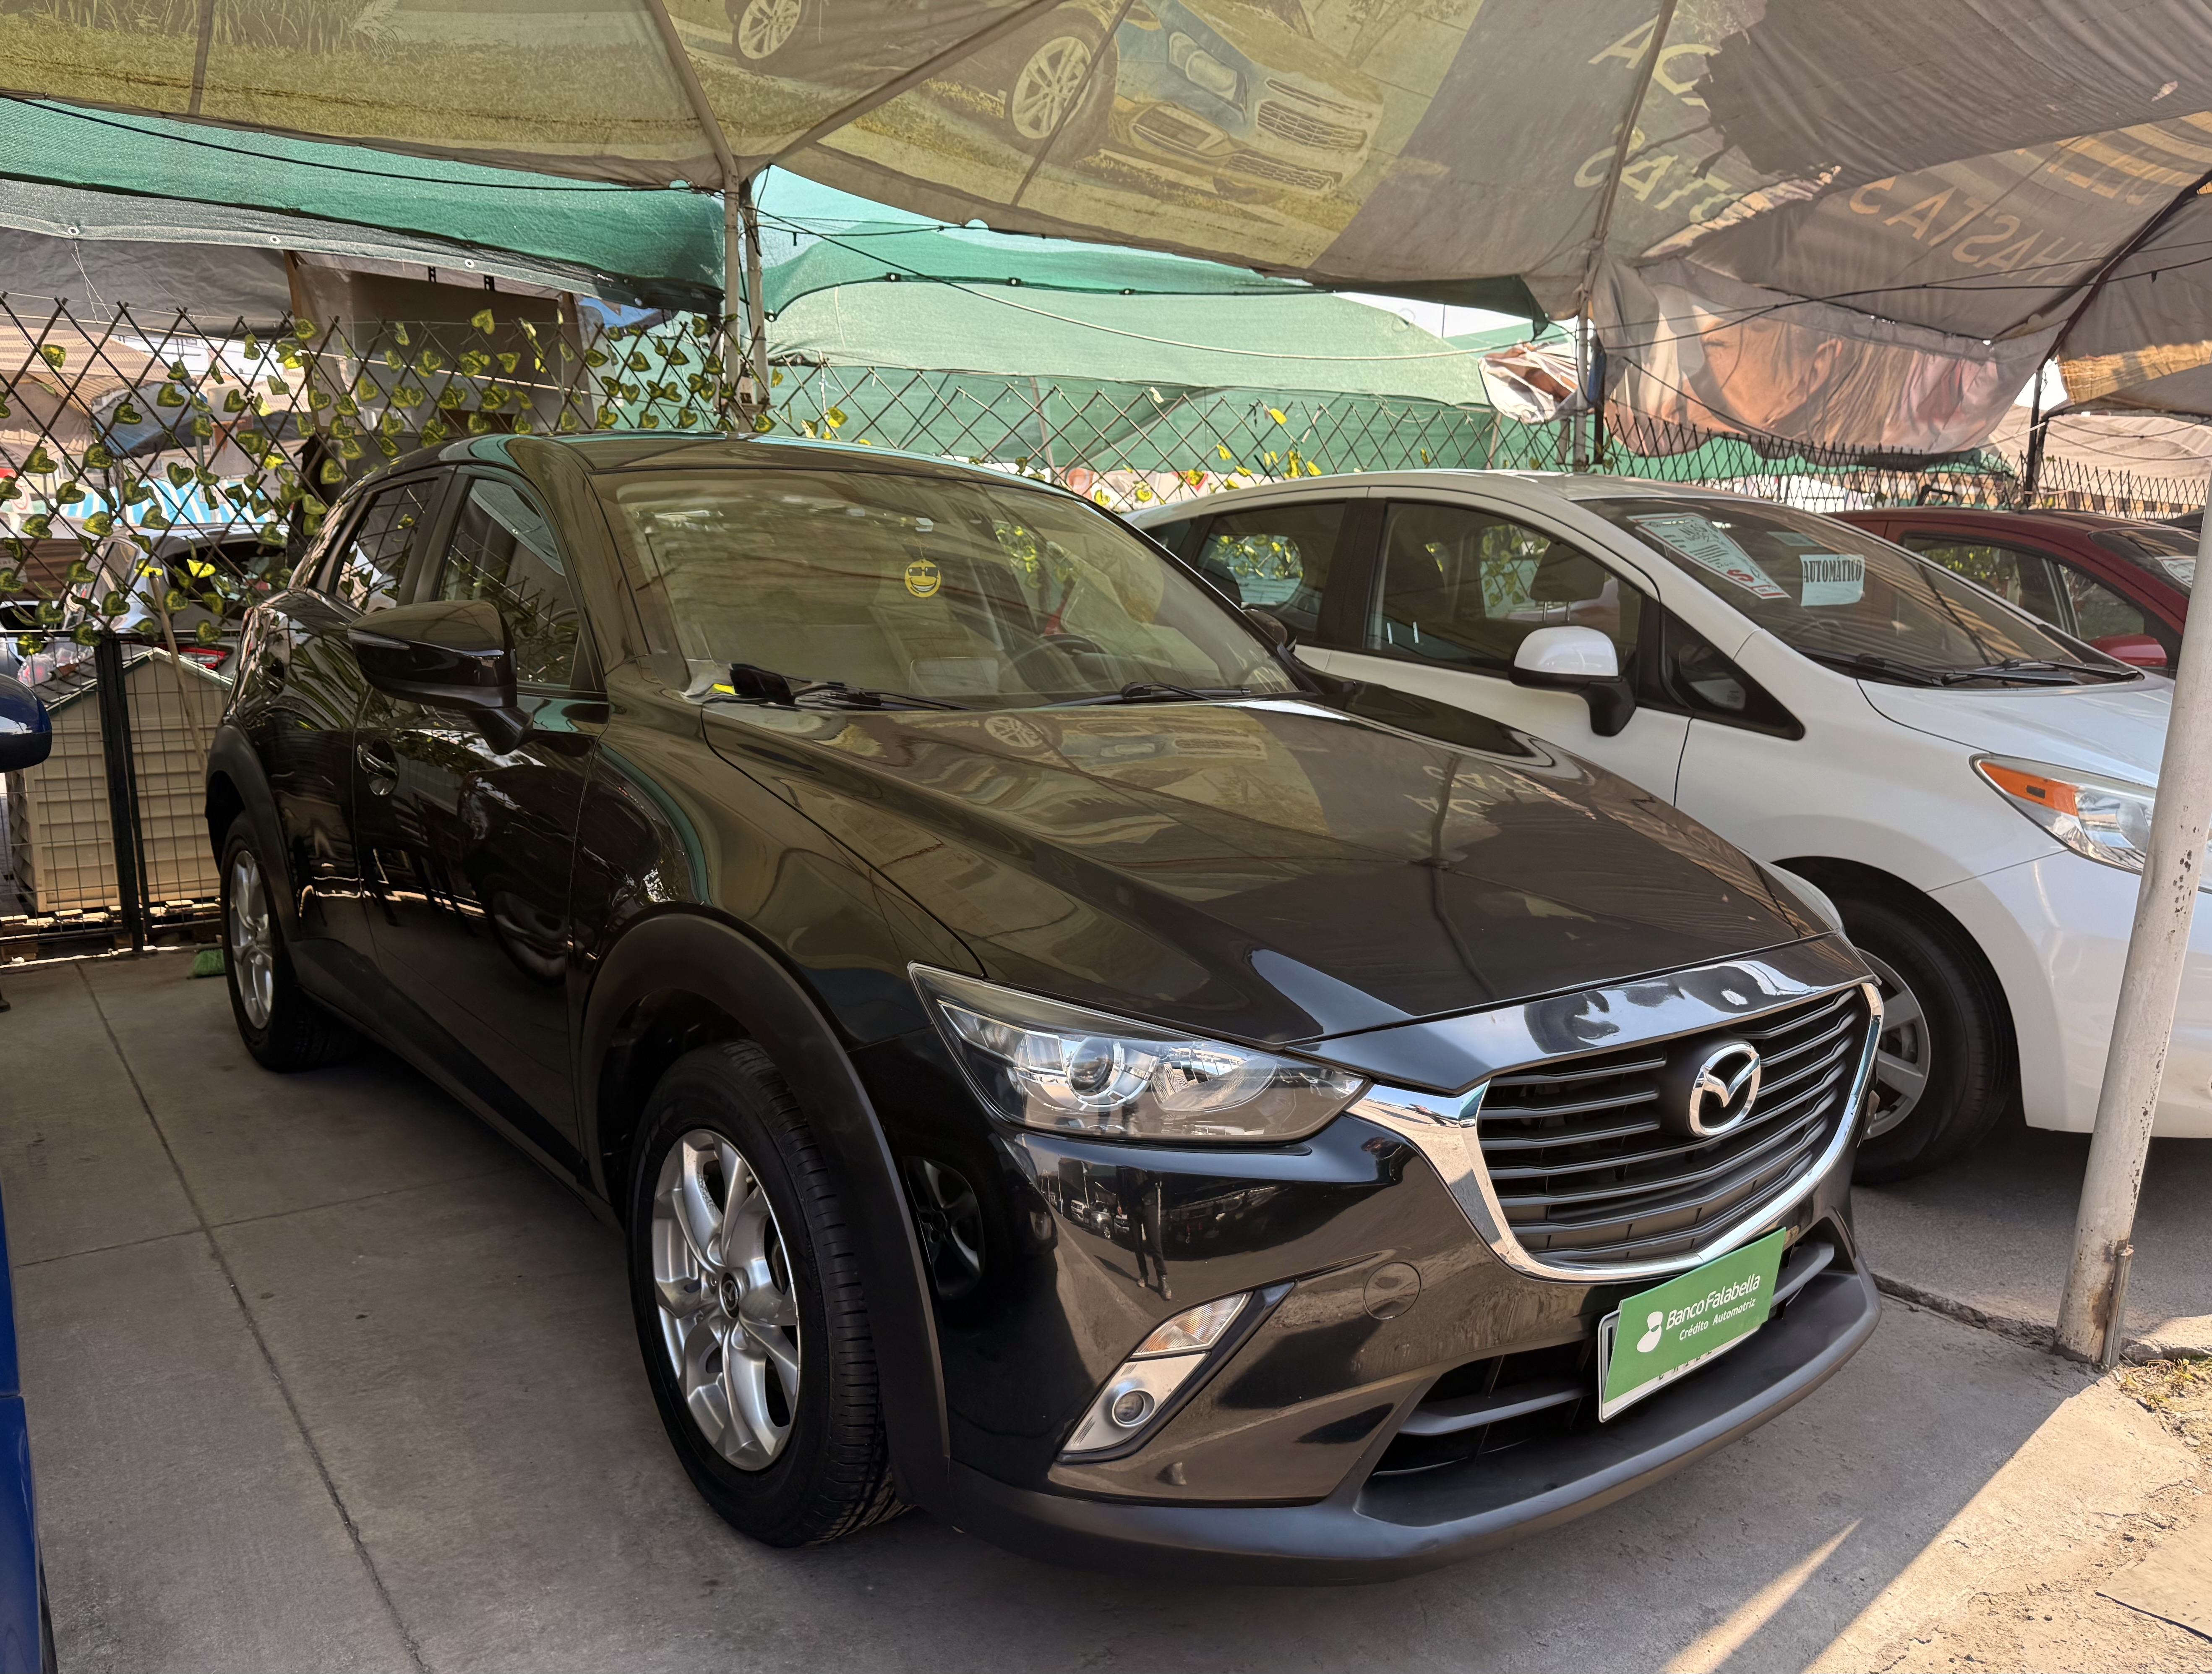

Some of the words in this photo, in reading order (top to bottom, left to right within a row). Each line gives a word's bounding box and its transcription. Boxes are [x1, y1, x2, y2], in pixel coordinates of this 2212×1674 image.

[1803, 556, 1862, 582] AUTOMÁTICO
[1666, 1300, 1705, 1330] Banco
[1705, 1273, 1761, 1311] Falabella
[1679, 1320, 1709, 1341] Crédito
[1712, 1297, 1756, 1326] Automotriz
